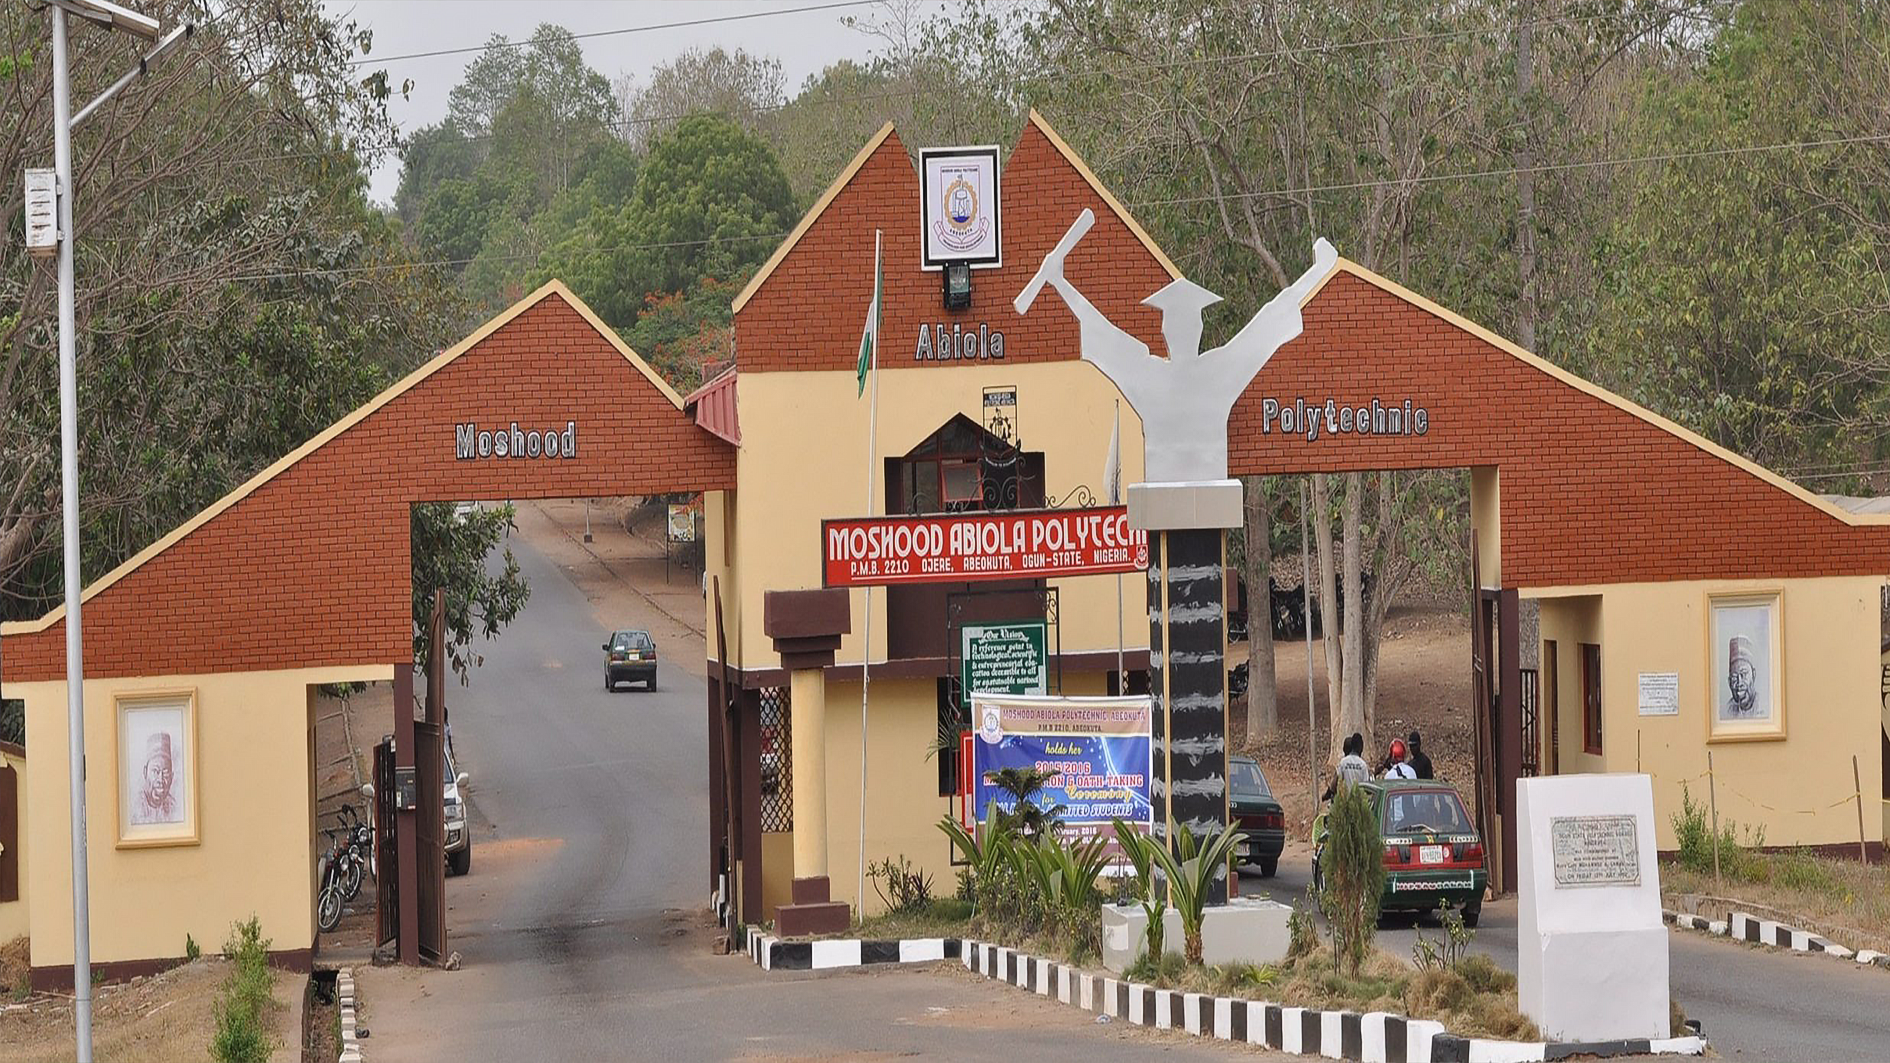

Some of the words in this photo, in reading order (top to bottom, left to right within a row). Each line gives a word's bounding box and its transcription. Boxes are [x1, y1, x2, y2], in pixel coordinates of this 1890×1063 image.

[915, 323, 1004, 360] Abiola
[1262, 397, 1428, 441] Polytechnic
[455, 420, 576, 459] Moshood
[829, 525, 944, 561] MOSHOOD
[950, 520, 1026, 557] ABIOLA
[1032, 513, 1147, 553] POLYTEC
[851, 560, 880, 575] P.M.B.
[884, 558, 910, 574] 2210
[921, 556, 955, 573] OJERE,
[963, 554, 1013, 572] ABEOKUTA,
[1093, 548, 1131, 564] NIGERIA.
[1003, 709, 1035, 720] MOSHOOD
[1037, 709, 1060, 720] ABIOLA
[1111, 710, 1146, 721] ABEOKUTA
[1045, 742, 1068, 755] holds
[1069, 742, 1083, 755] her
[1035, 760, 1092, 775] 2015/2016
[1077, 775, 1105, 788] OATH
[1106, 774, 1144, 787] TAKING
[1041, 792, 1055, 808] for
[1065, 785, 1134, 803] Ceremony
[1091, 802, 1134, 817] STUDENTS
